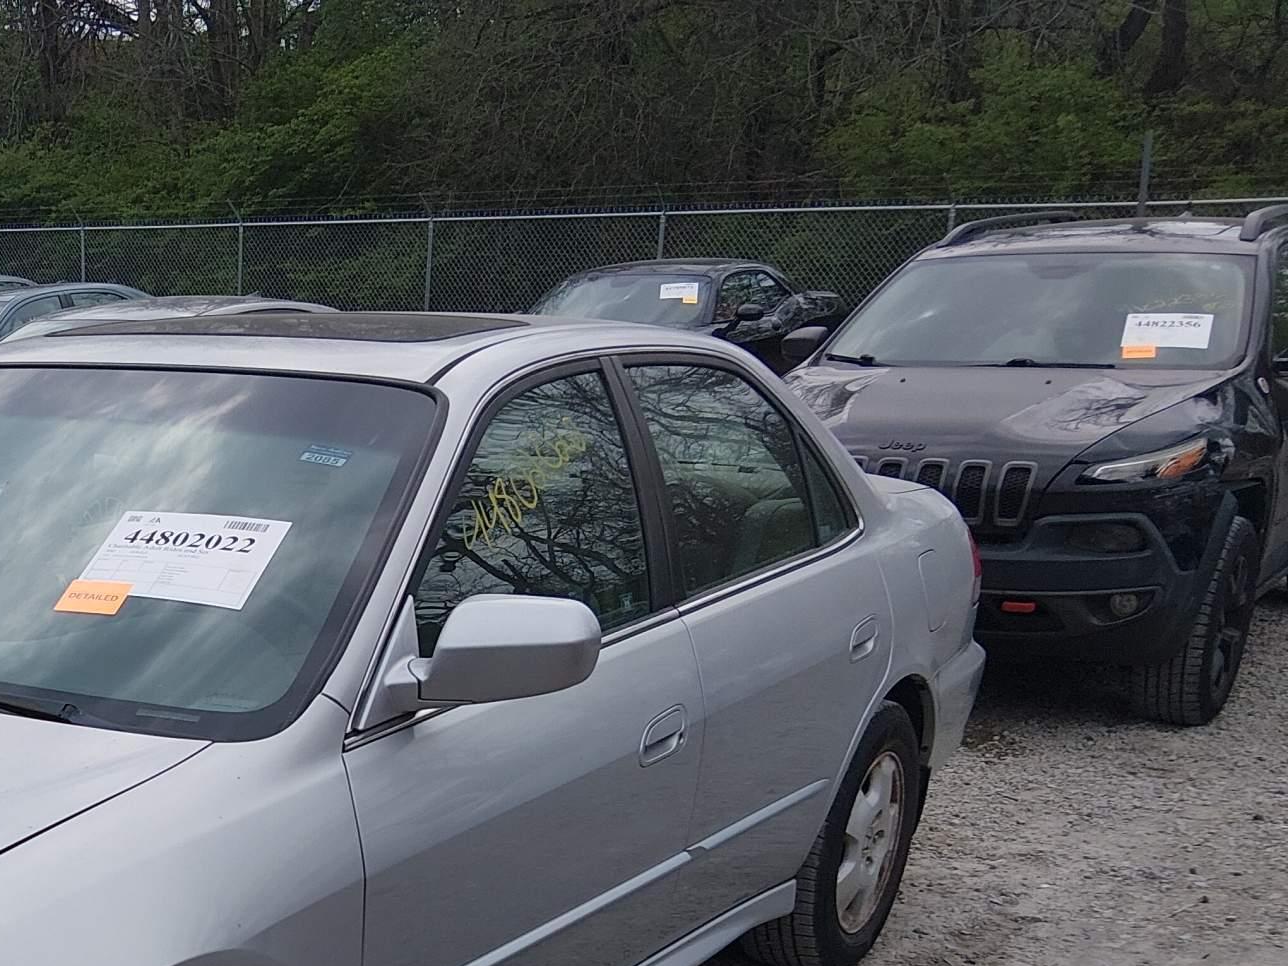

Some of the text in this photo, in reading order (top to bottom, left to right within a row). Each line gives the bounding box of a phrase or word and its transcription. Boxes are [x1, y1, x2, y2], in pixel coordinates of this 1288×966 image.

[1135, 320, 1201, 328] 44822356
[878, 440, 927, 453] Jeep
[124, 528, 256, 554] 44802022
[68, 592, 119, 602] DETAILED
